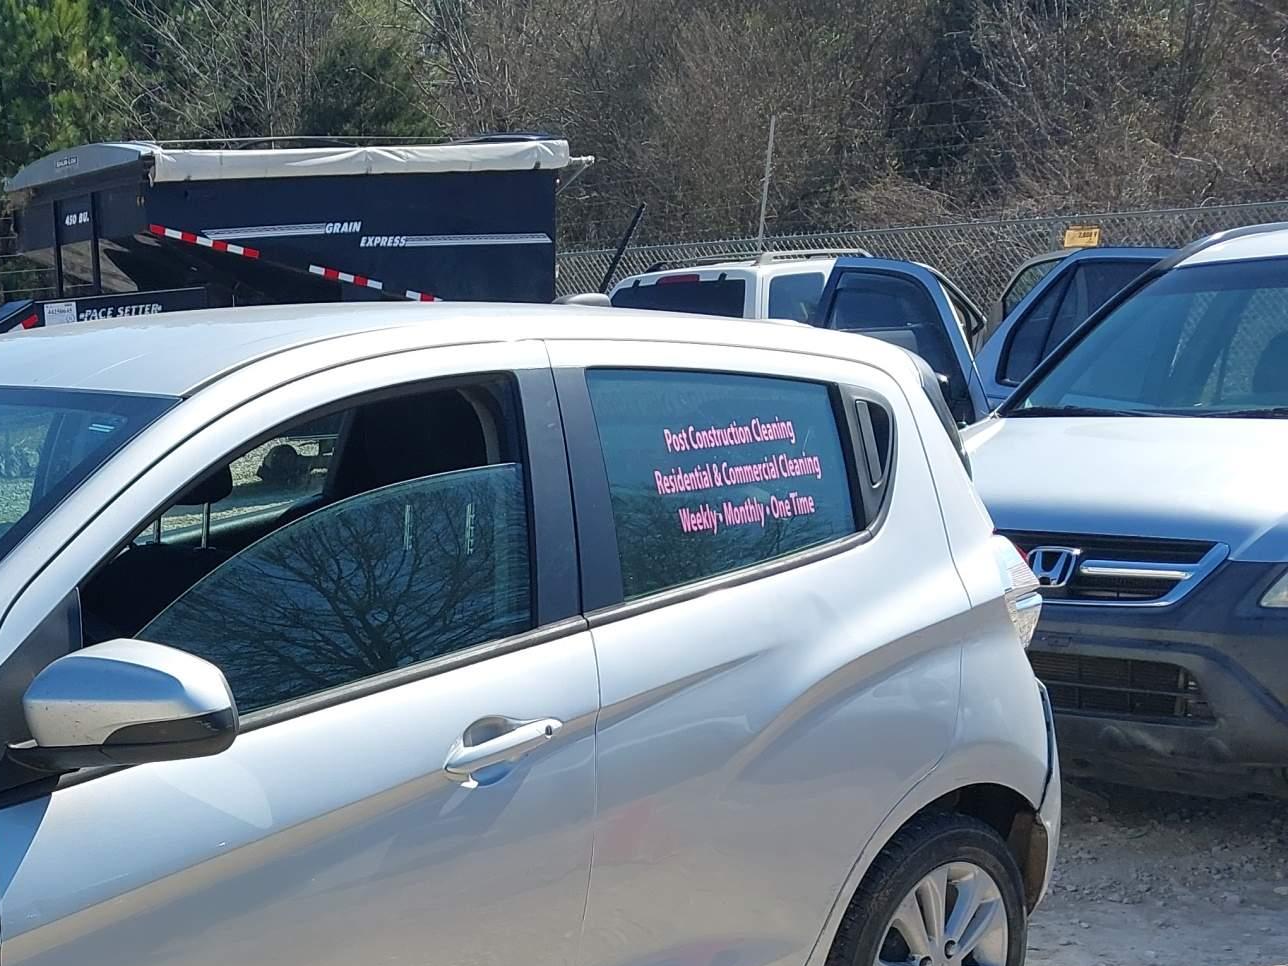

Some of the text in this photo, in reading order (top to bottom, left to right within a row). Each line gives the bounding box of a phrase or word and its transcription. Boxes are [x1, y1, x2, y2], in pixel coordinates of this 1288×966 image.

[325, 221, 362, 234] GRAIN
[360, 236, 407, 248] EXPRESS
[84, 307, 114, 321] PACE
[116, 303, 159, 318] SETTER
[664, 416, 796, 452] Post Construction Cleaning
[654, 451, 822, 495] Residential & Commercial Cleaning
[678, 491, 815, 536] Weekly Monthly One Time
